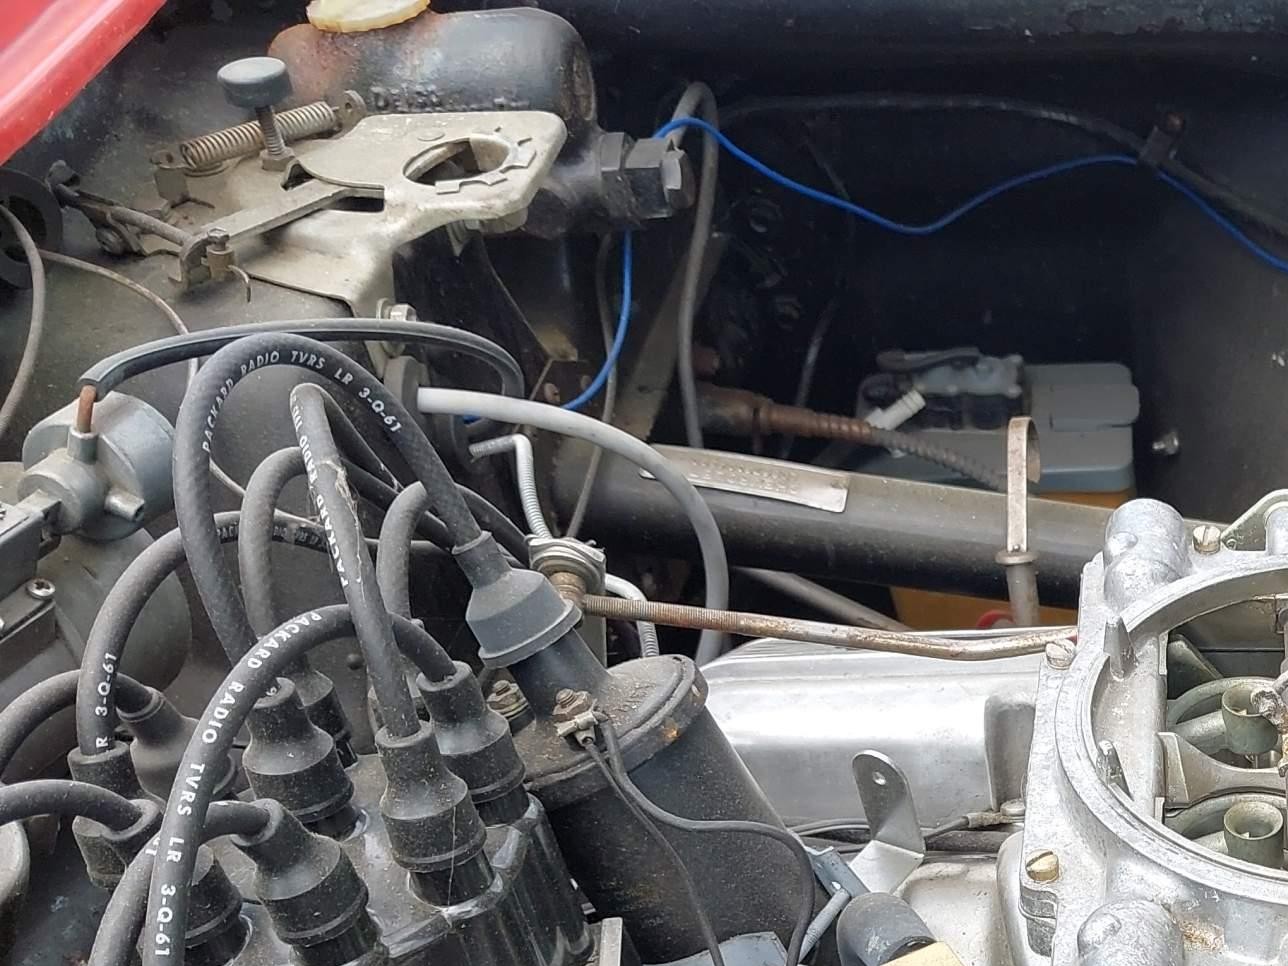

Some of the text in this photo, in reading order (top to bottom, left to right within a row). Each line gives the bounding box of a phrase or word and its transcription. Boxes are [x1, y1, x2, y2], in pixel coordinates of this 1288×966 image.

[202, 350, 402, 453] PACKARD RADIO TVRS LR 3-Q-61
[95, 652, 117, 748] R 3-Q-61
[154, 611, 322, 956] PACKARD RADIO TVRS LR 3-Q-61
